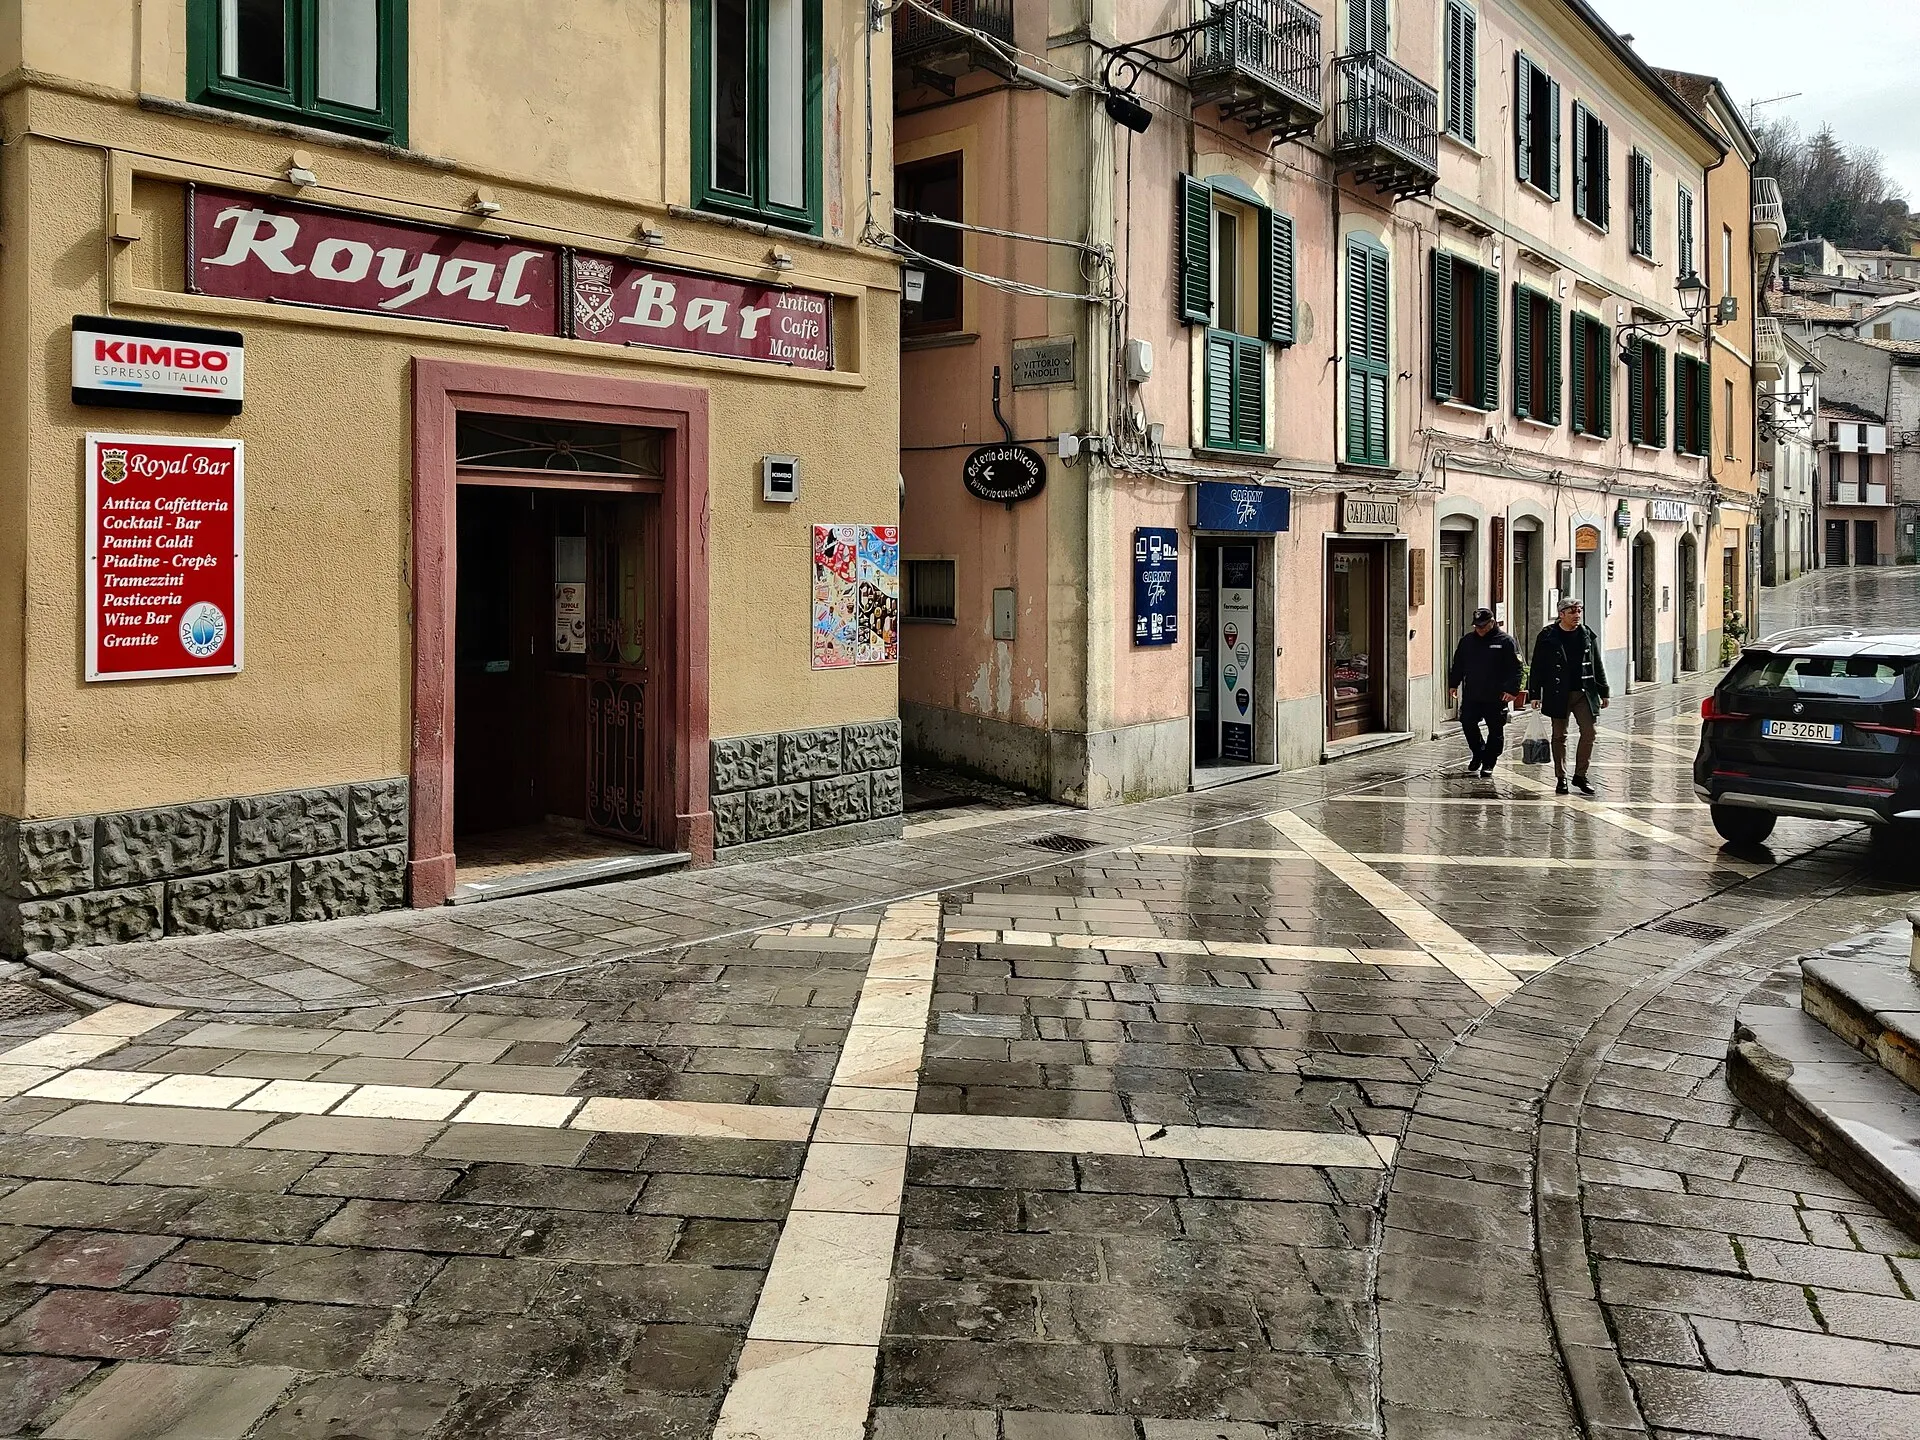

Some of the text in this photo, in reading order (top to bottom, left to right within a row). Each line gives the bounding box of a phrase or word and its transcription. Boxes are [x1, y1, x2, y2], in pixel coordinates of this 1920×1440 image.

[201, 205, 772, 340] Royal Bar
[776, 291, 823, 314] Antico
[780, 316, 819, 339] Caffè
[94, 339, 228, 372] KIMBO
[769, 338, 829, 362] Maradei
[1023, 357, 1060, 369] VITTORIO
[94, 365, 228, 386] ESPRESSO ITALIANO
[1023, 367, 1060, 379] PANDOLFI
[130, 453, 231, 480] Royal Bar
[997, 448, 1012, 460] del
[1013, 448, 1039, 475] Vicolo
[102, 496, 229, 514] Antica Caffetteria
[1231, 489, 1263, 503] CARMY
[1346, 502, 1397, 525] CAPRICCI
[103, 516, 163, 530] Cocktail
[174, 518, 202, 530] Bar
[102, 535, 194, 549] Panini Caldi
[102, 554, 160, 568] Piadine
[172, 553, 218, 571] Crepês
[103, 573, 185, 588] Tramezzini
[1142, 571, 1172, 583] CARMY
[102, 592, 182, 607] Pasticceria
[104, 612, 173, 627] Wine Bar
[103, 633, 159, 648] Granite
[195, 621, 224, 655] BORBONE
